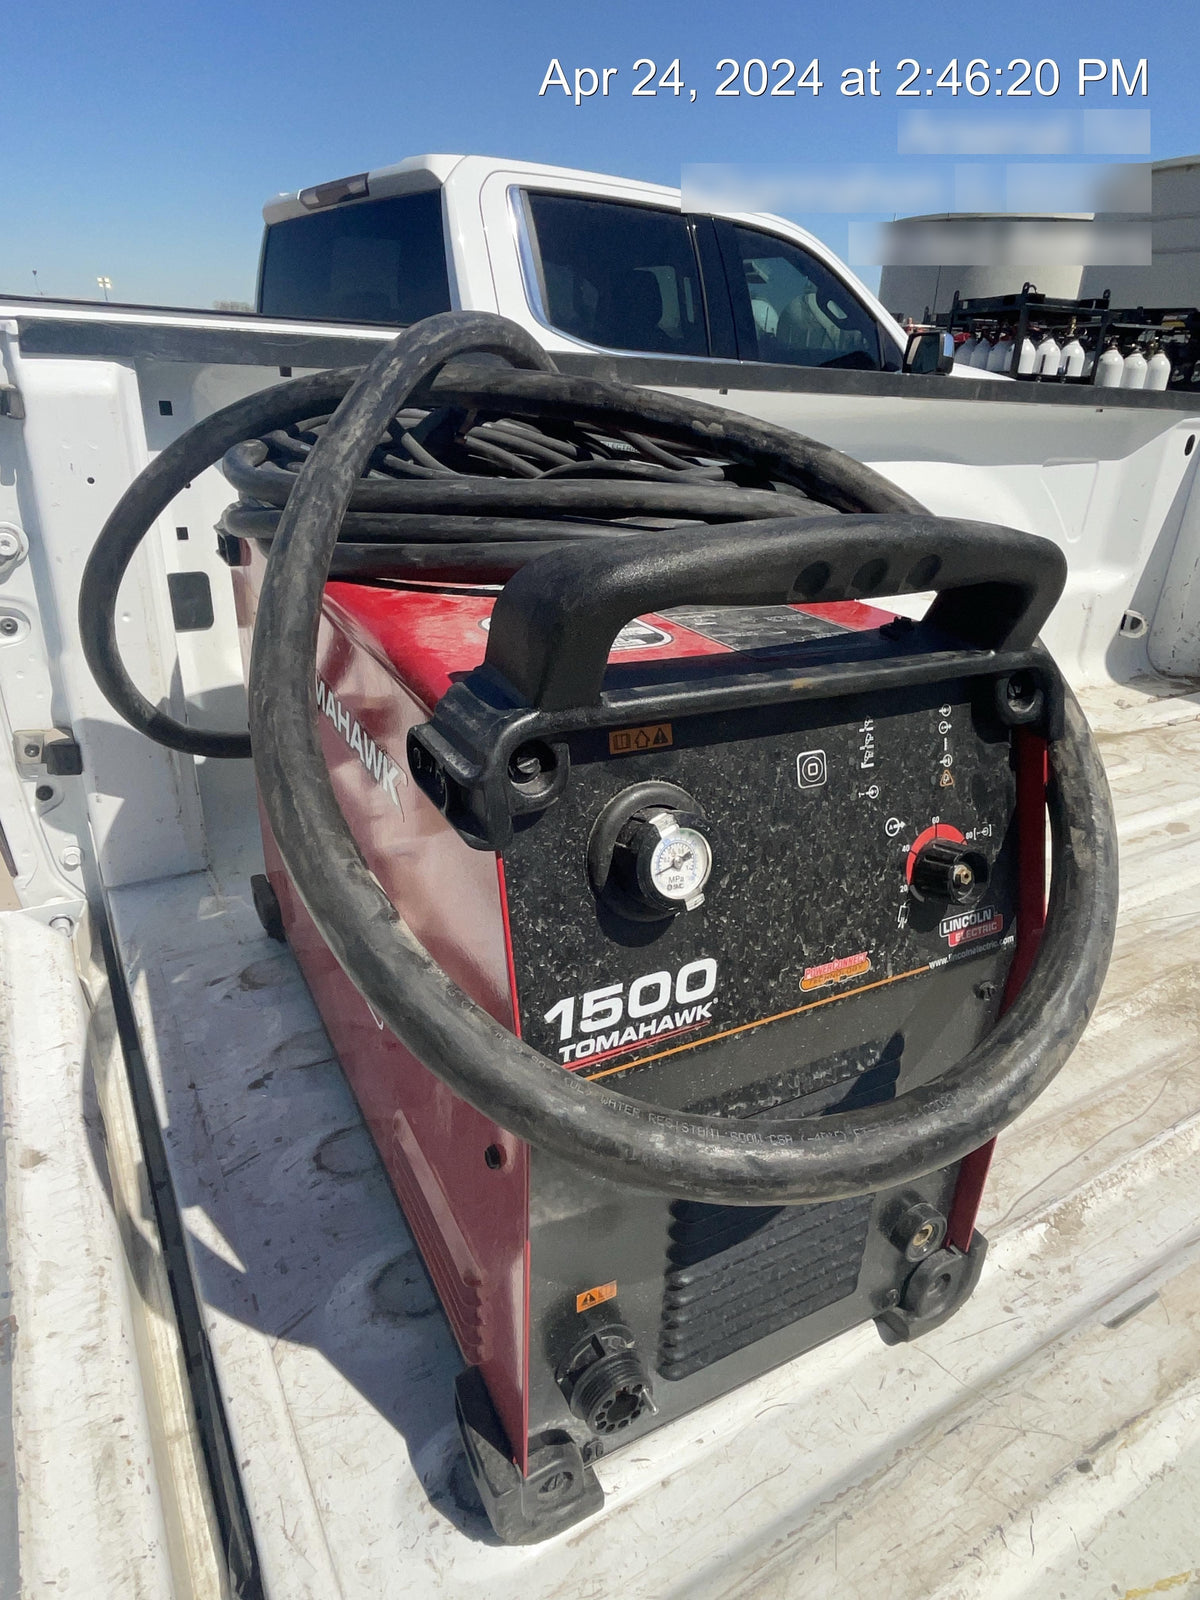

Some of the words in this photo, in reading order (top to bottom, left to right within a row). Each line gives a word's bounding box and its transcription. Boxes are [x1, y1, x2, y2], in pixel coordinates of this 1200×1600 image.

[901, 844, 910, 853] 40
[899, 884, 908, 893] 20
[942, 908, 992, 935] LINCOLN
[955, 922, 998, 943] ELECTRIC
[928, 935, 1014, 969] www.lincolnelectric.com
[542, 957, 719, 1041] 1500
[558, 1000, 714, 1064] TOMAHAWK
[600, 1095, 641, 1120] WATER
[769, 1133, 794, 1147] CSA
